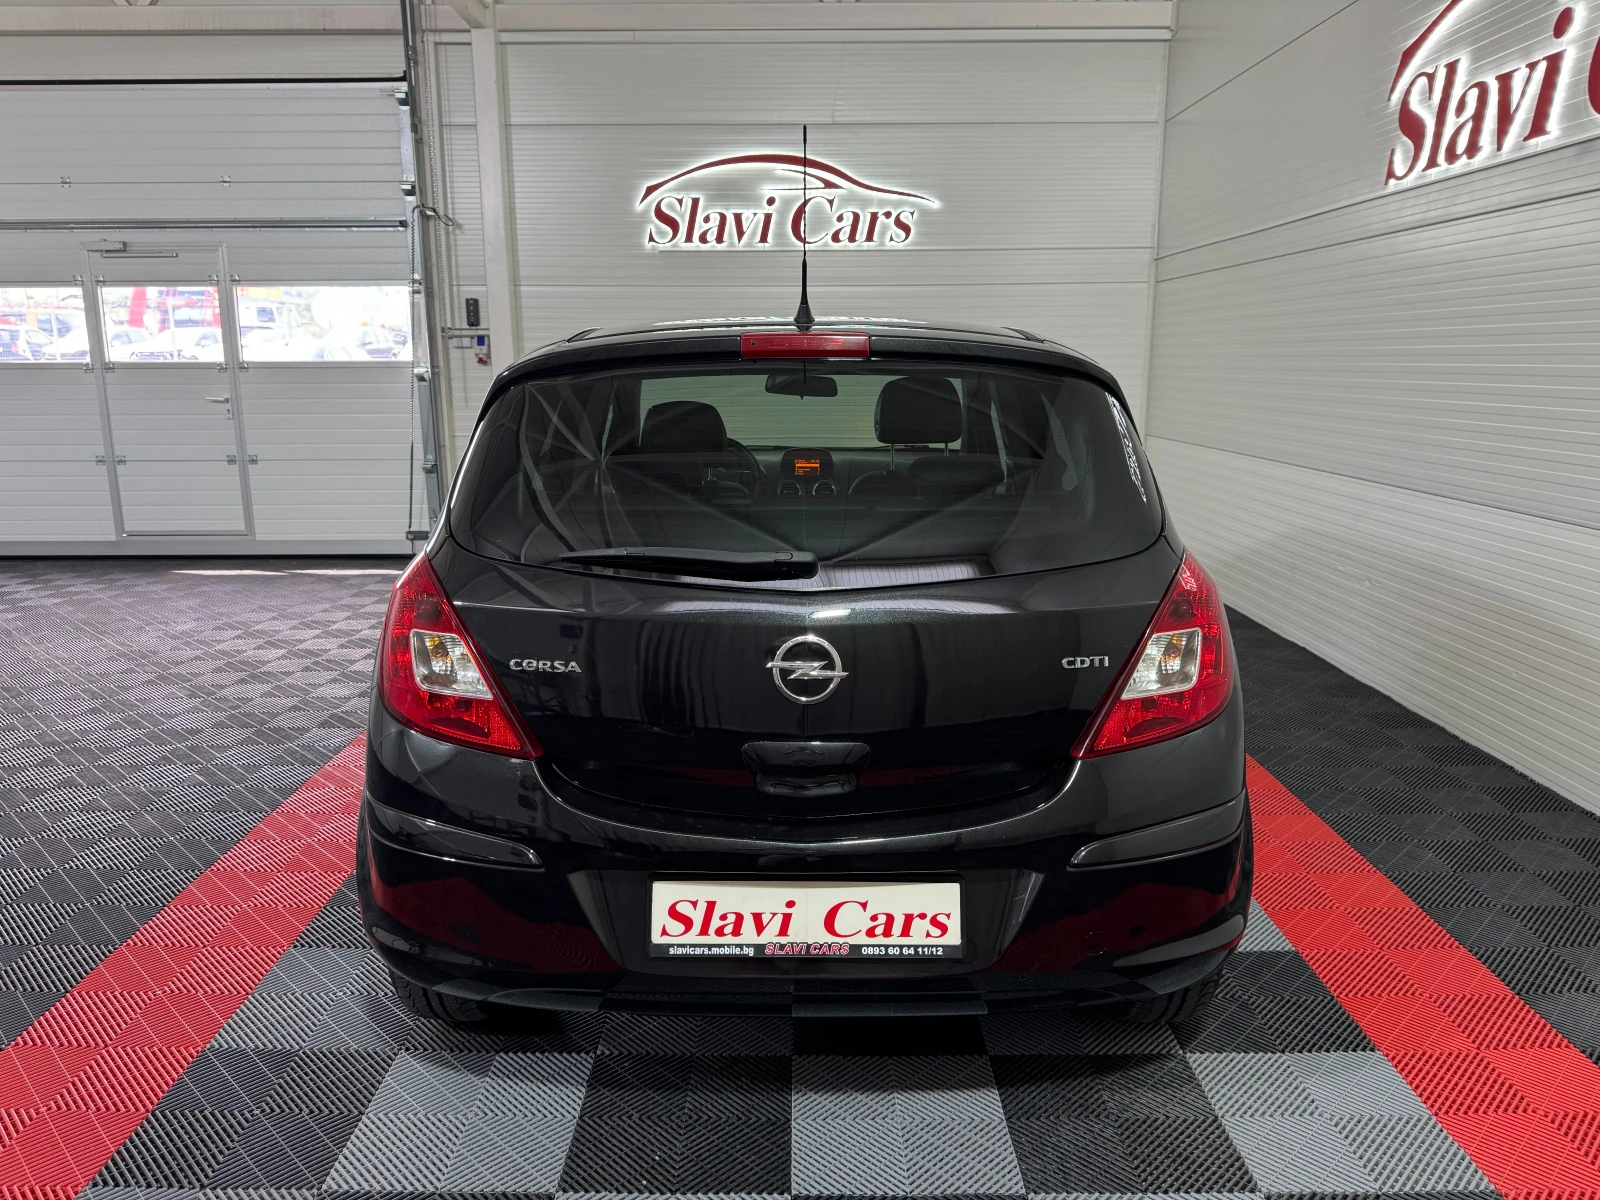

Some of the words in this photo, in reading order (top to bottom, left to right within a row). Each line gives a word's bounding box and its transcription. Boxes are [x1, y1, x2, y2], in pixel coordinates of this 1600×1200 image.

[1384, 6, 1575, 187] Slavi
[647, 195, 777, 246] Slavi
[790, 195, 916, 246] Cars
[509, 658, 583, 673] CORSA
[1061, 655, 1110, 670] CDTI
[660, 899, 797, 938] Slavi
[823, 899, 952, 939] Cars
[669, 945, 754, 957] slavicars.mobile.bg
[764, 942, 807, 955] SLAVI
[809, 942, 850, 955] CARS
[861, 946, 886, 955] 0893
[887, 946, 900, 955] 60
[902, 946, 915, 955] 64
[917, 946, 943, 956] 11/12
